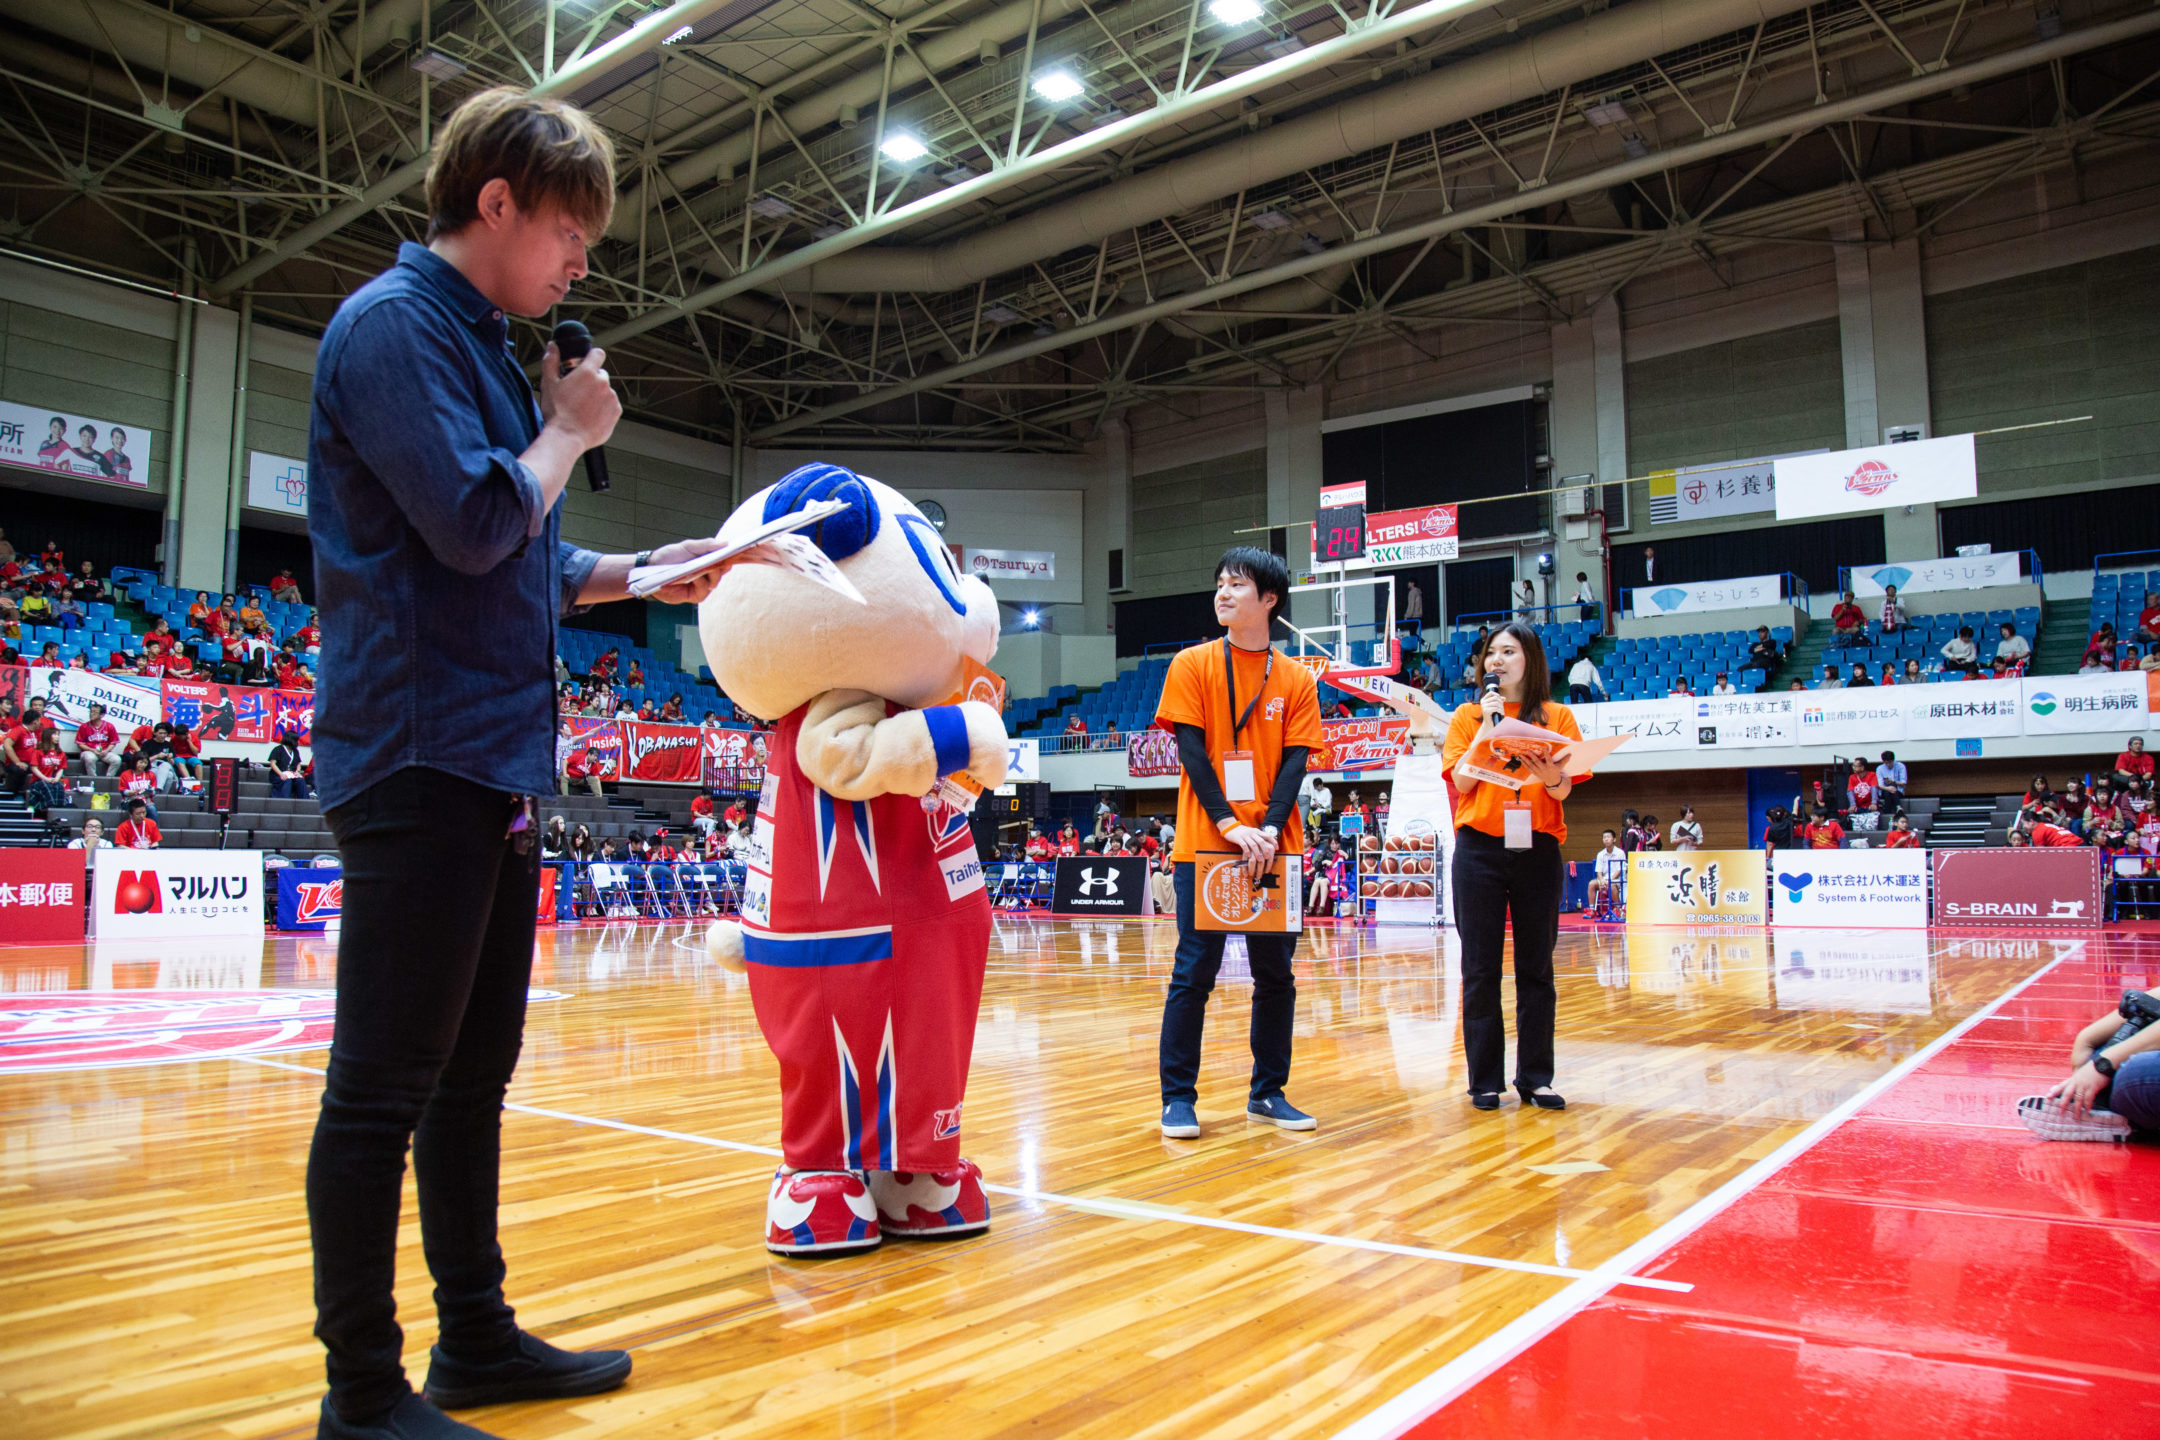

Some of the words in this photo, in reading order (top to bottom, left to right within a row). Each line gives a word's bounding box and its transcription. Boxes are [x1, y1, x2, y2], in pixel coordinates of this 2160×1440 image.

[1366, 521, 1419, 544] LTERS!
[1327, 527, 1360, 557] 24
[1371, 547, 1402, 563] RKK
[1403, 541, 1456, 560] 熊本放送
[990, 558, 1048, 574] Tsuruya
[1922, 565, 1996, 581] そらひろ
[1696, 586, 1760, 603] そらひろ
[92, 686, 139, 710] DAIKI
[167, 683, 208, 696] VOLTERS
[1930, 701, 1998, 717] 原田木材
[2064, 694, 2138, 712] 明生病院
[166, 695, 203, 730] 海
[236, 694, 271, 727] 斗
[589, 735, 622, 749] Inside
[626, 722, 698, 778] KOBAYASHI
[1010, 799, 1020, 812] 0
[945, 861, 981, 885] Taihe
[1818, 874, 1920, 887] 株式会社八木運送
[168, 876, 248, 901] マルハン
[1817, 893, 1857, 904] System
[1859, 893, 1867, 902] &
[1869, 893, 1921, 902] Footwork
[1945, 902, 2037, 915] S-BRAIN
